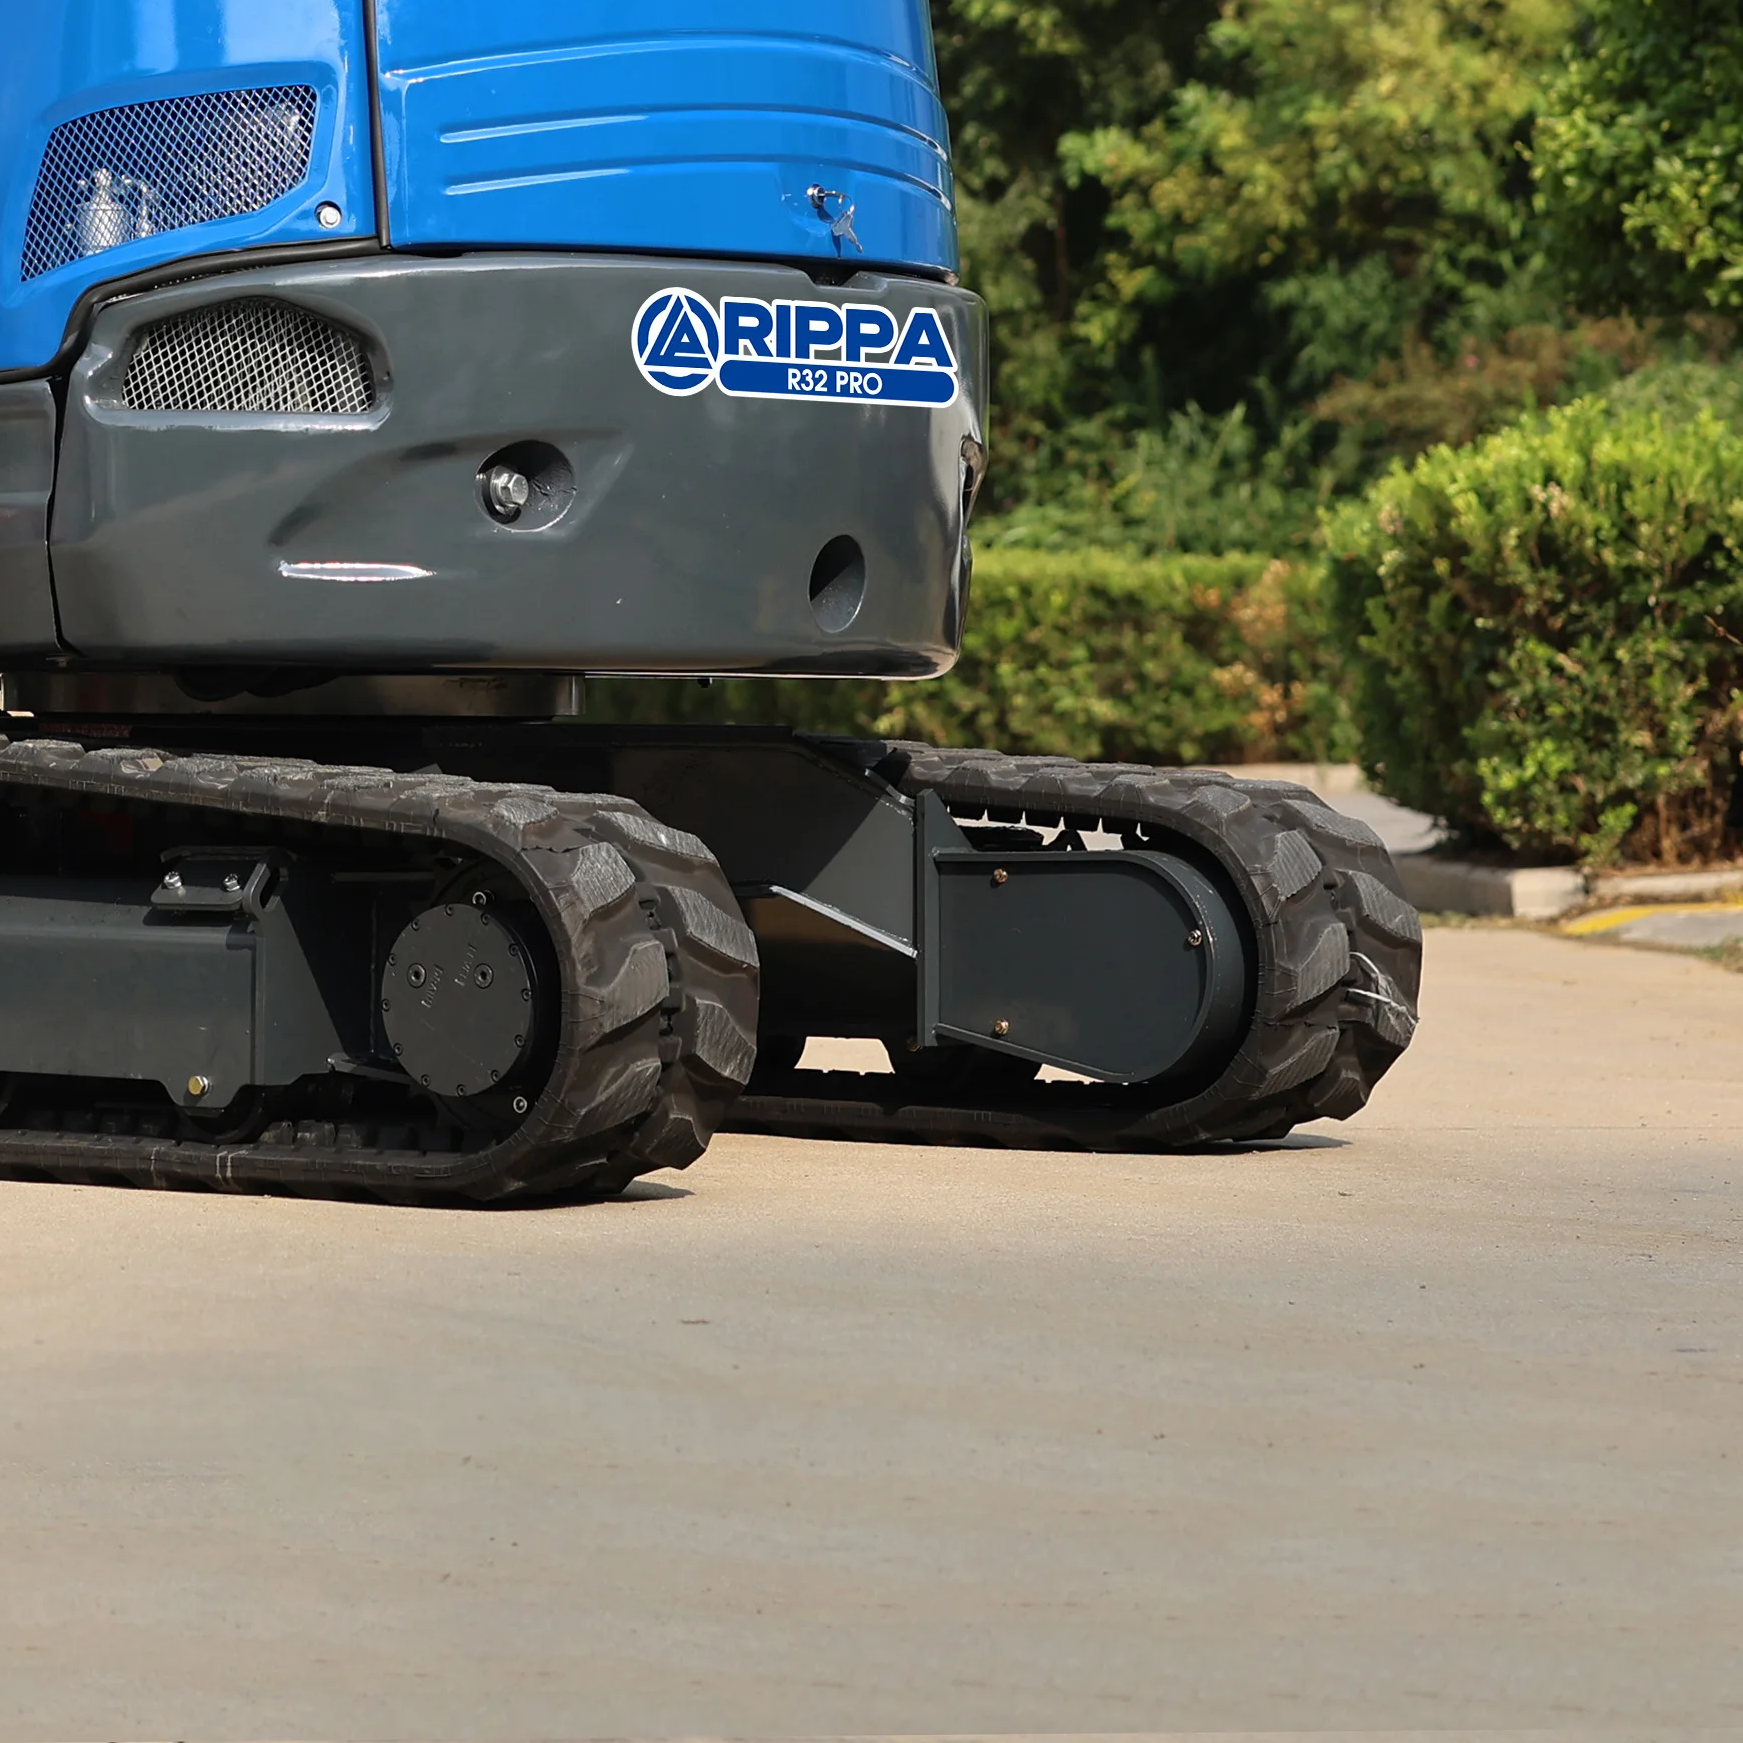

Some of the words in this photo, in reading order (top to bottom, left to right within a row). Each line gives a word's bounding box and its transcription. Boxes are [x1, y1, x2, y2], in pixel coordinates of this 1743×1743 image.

[723, 300, 955, 369] RIPPA
[787, 367, 828, 392] R32
[835, 370, 883, 395] PRO
